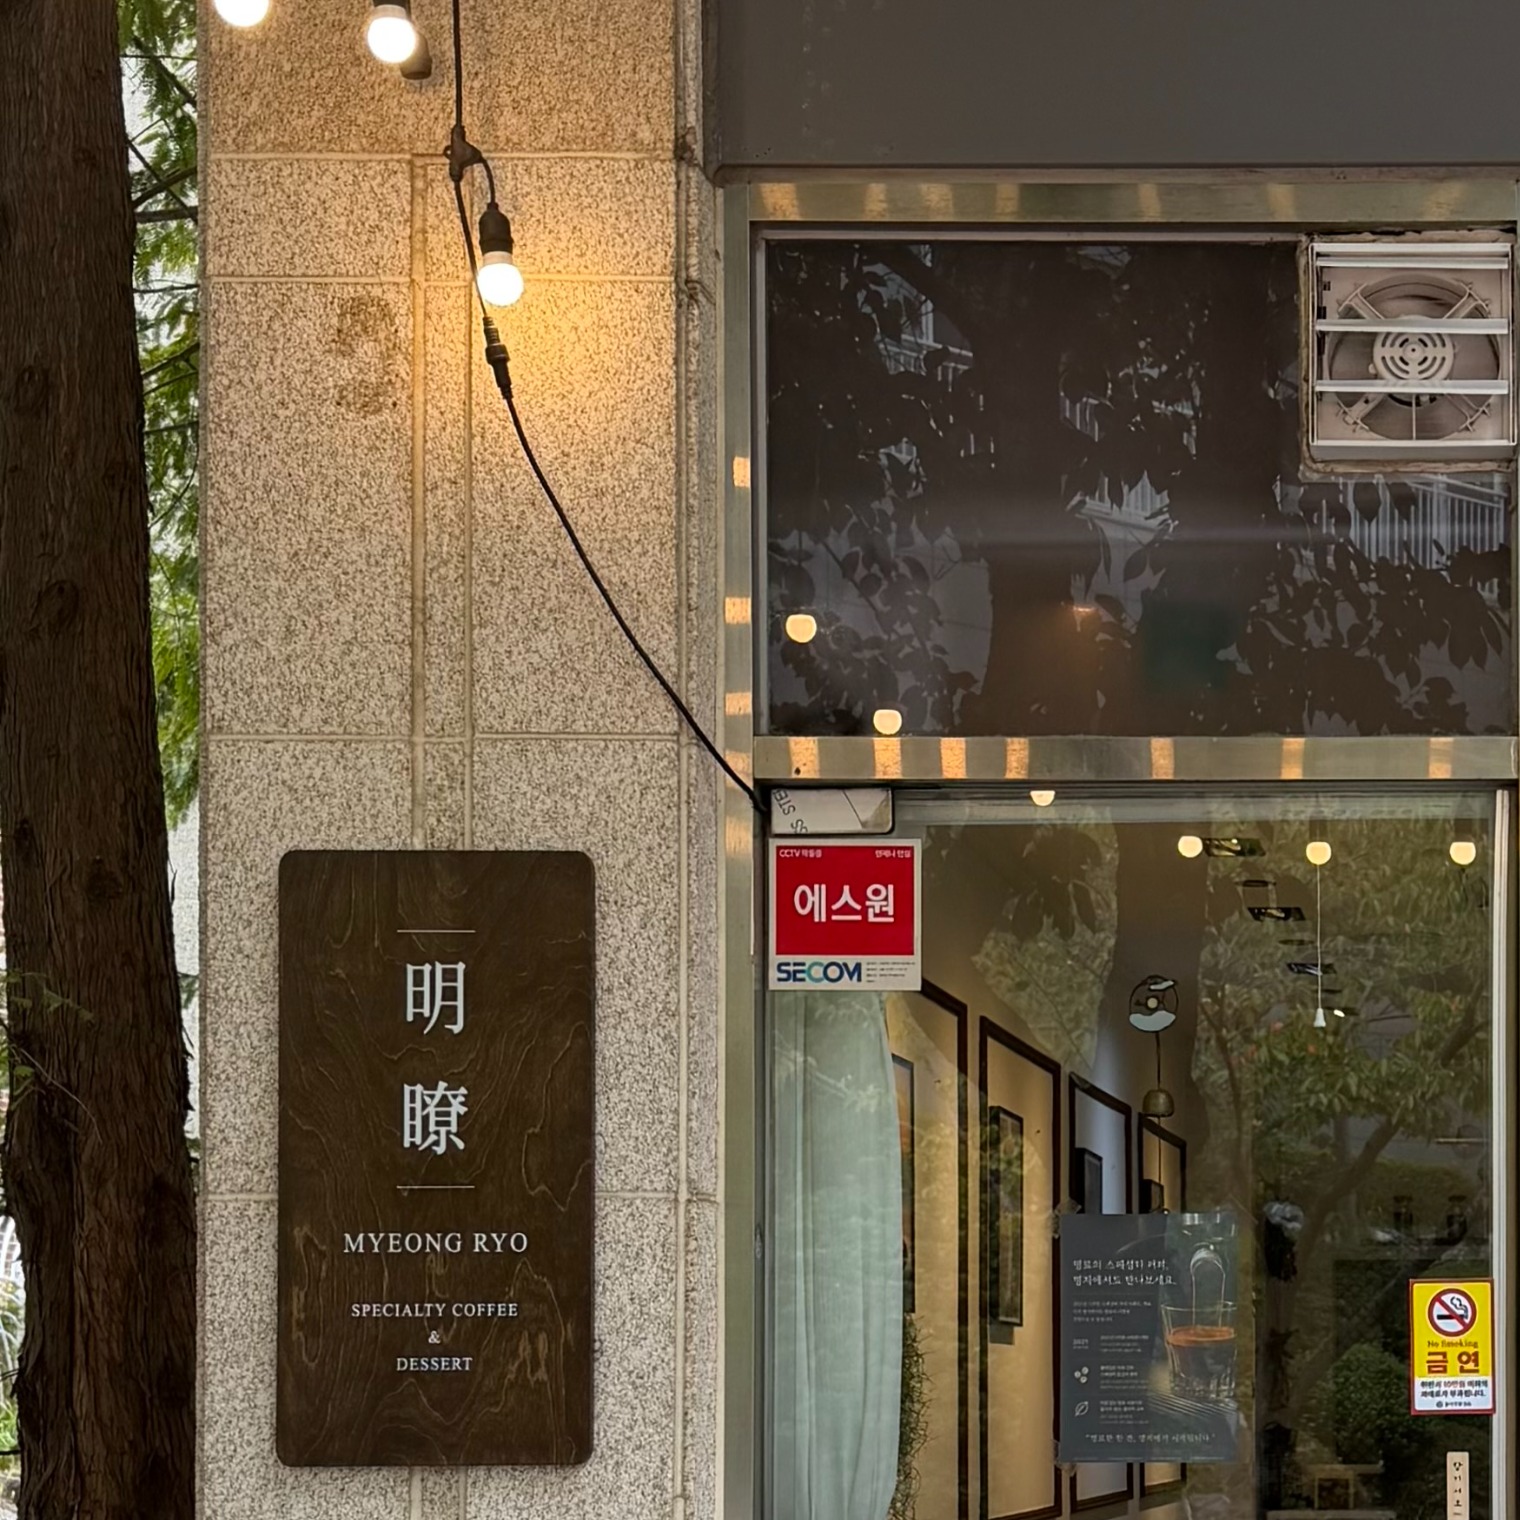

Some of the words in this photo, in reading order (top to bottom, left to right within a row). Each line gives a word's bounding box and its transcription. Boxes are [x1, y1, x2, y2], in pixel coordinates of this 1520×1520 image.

[779, 848, 801, 858] CCTV
[793, 883, 895, 923] 에스원
[776, 961, 862, 983] SECOM
[402, 960, 469, 1156] 明瞭
[343, 1231, 464, 1254] MYEONG
[472, 1231, 530, 1254] RYO
[350, 1302, 446, 1318] SPECIALTY
[452, 1301, 519, 1317] COFFEE
[428, 1330, 442, 1345] &
[1427, 1340, 1440, 1349] No
[1441, 1339, 1479, 1350] Smoking
[396, 1356, 474, 1372] DESSERT
[1426, 1350, 1480, 1374] 금연
